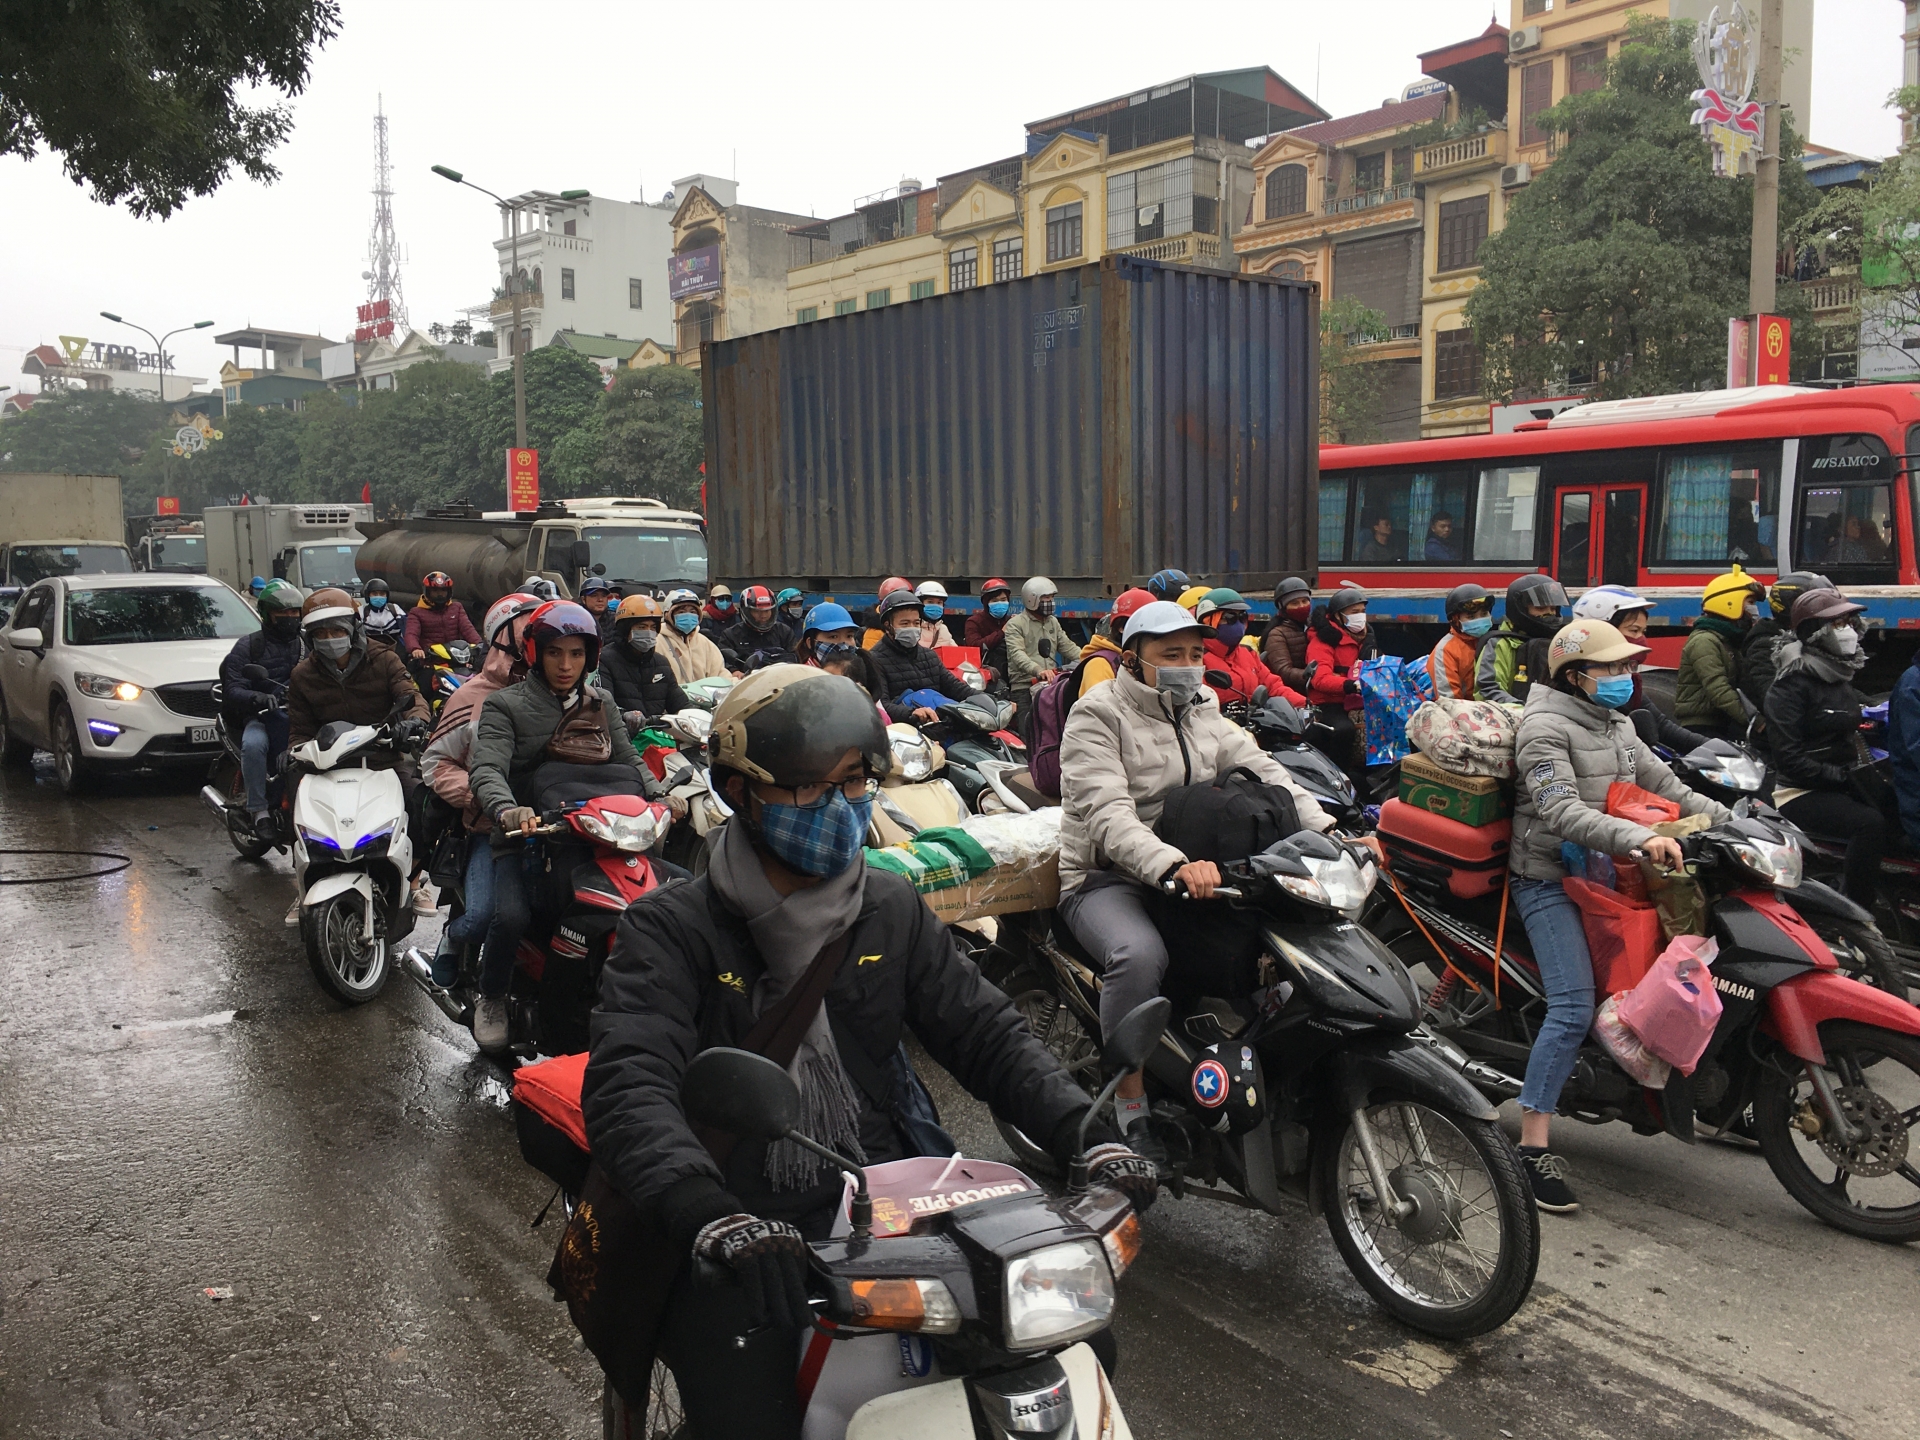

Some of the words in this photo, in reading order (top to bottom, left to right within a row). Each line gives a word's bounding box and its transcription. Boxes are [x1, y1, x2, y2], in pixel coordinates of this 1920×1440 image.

[91, 342, 176, 370] TPBank
[1829, 455, 1880, 468] SAMCO
[193, 728, 216, 741] 30A
[560, 925, 586, 945] YAMAHA
[1710, 975, 1755, 1001] AMAHA
[1307, 1019, 1343, 1037] HONDA
